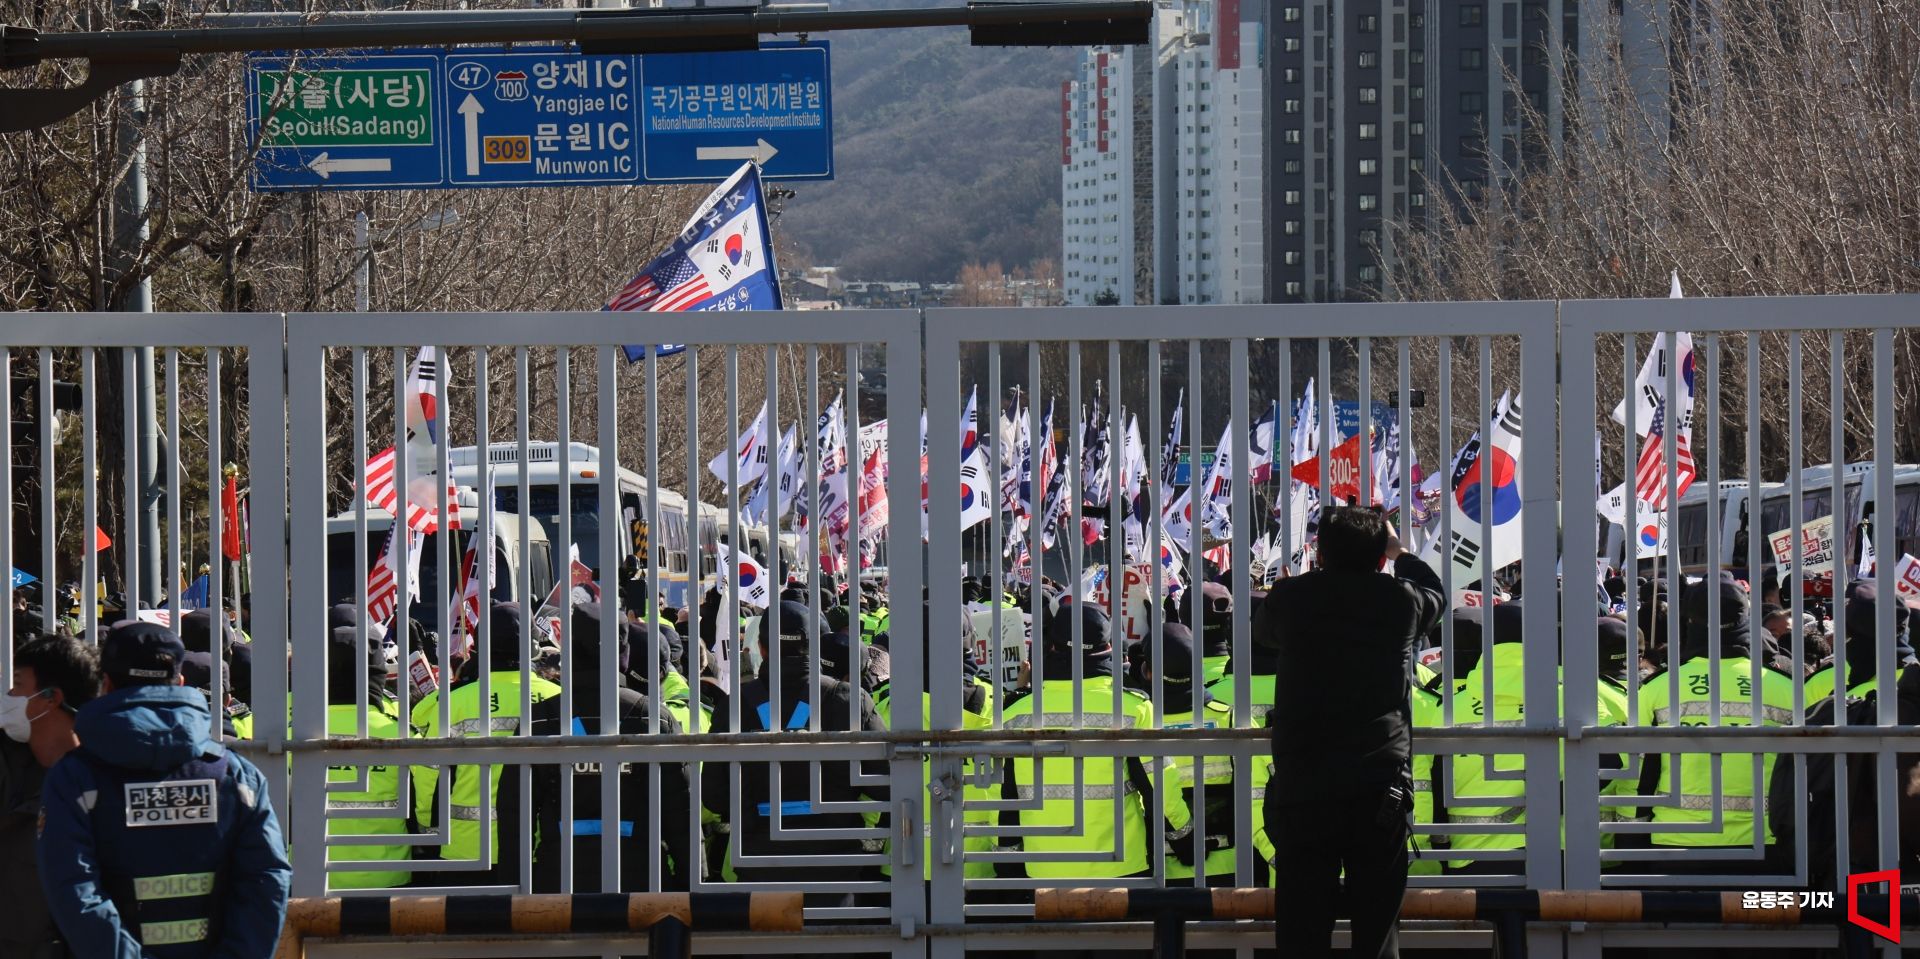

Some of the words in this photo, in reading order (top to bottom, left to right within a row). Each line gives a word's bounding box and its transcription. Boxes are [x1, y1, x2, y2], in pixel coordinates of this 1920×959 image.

[458, 67, 482, 85] 47
[500, 81, 523, 98] 100
[651, 81, 821, 113] 국가공무원인재개발원
[532, 94, 605, 116] Yangjae
[610, 93, 629, 111] IC
[652, 114, 682, 131] National
[682, 114, 708, 129] Human
[708, 113, 745, 129] Resources
[745, 112, 792, 131] Development
[792, 112, 821, 127] Institute
[488, 140, 526, 160] 309
[536, 156, 608, 175] Munwon
[614, 155, 632, 173] IC
[131, 785, 209, 808] 과천청사
[133, 807, 209, 822] POLICE
[139, 876, 208, 897] POLICE
